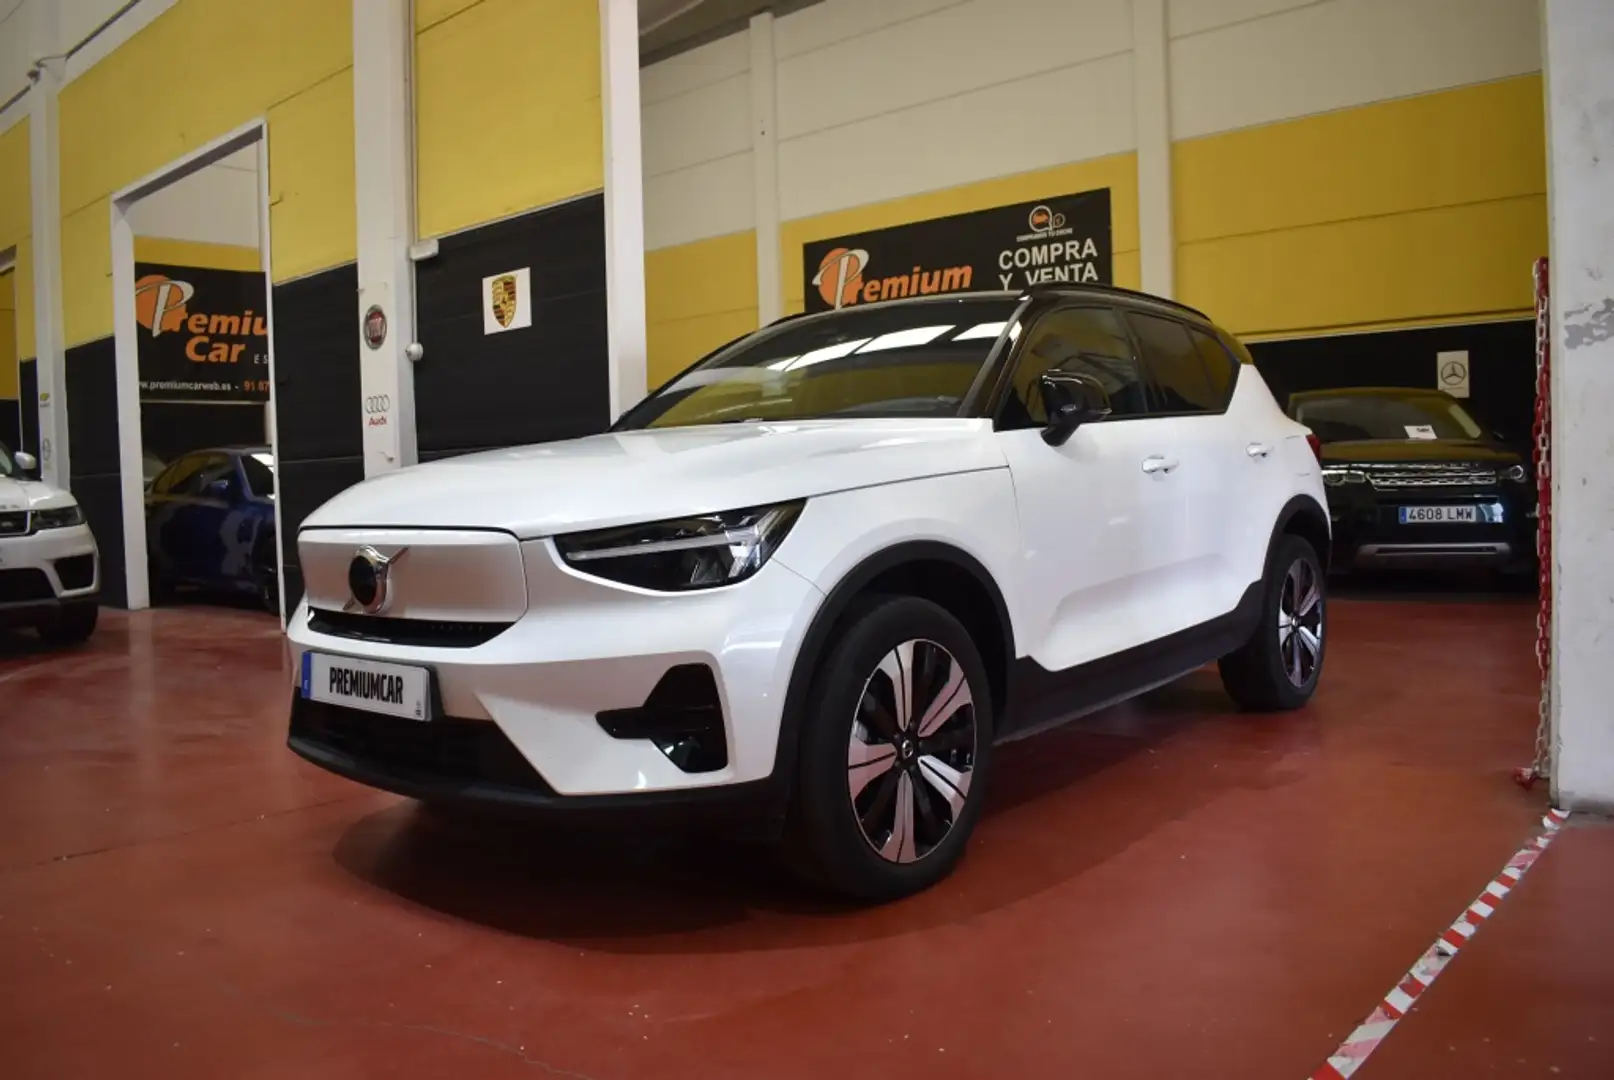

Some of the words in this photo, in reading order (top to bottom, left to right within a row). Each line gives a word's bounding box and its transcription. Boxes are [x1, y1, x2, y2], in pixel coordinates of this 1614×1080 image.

[998, 238, 1098, 270] COMPRA
[812, 248, 973, 310] Premium
[998, 272, 1013, 291] Y
[1025, 262, 1099, 286] VENTA
[135, 279, 268, 338] Premiu
[185, 335, 246, 363] Car
[138, 380, 231, 391] w.premiumcarweb.es
[368, 415, 388, 426] Audi
[1408, 507, 1443, 520] 4608
[1446, 507, 1474, 521] LMW
[329, 666, 404, 705] PREMIUMCAR
